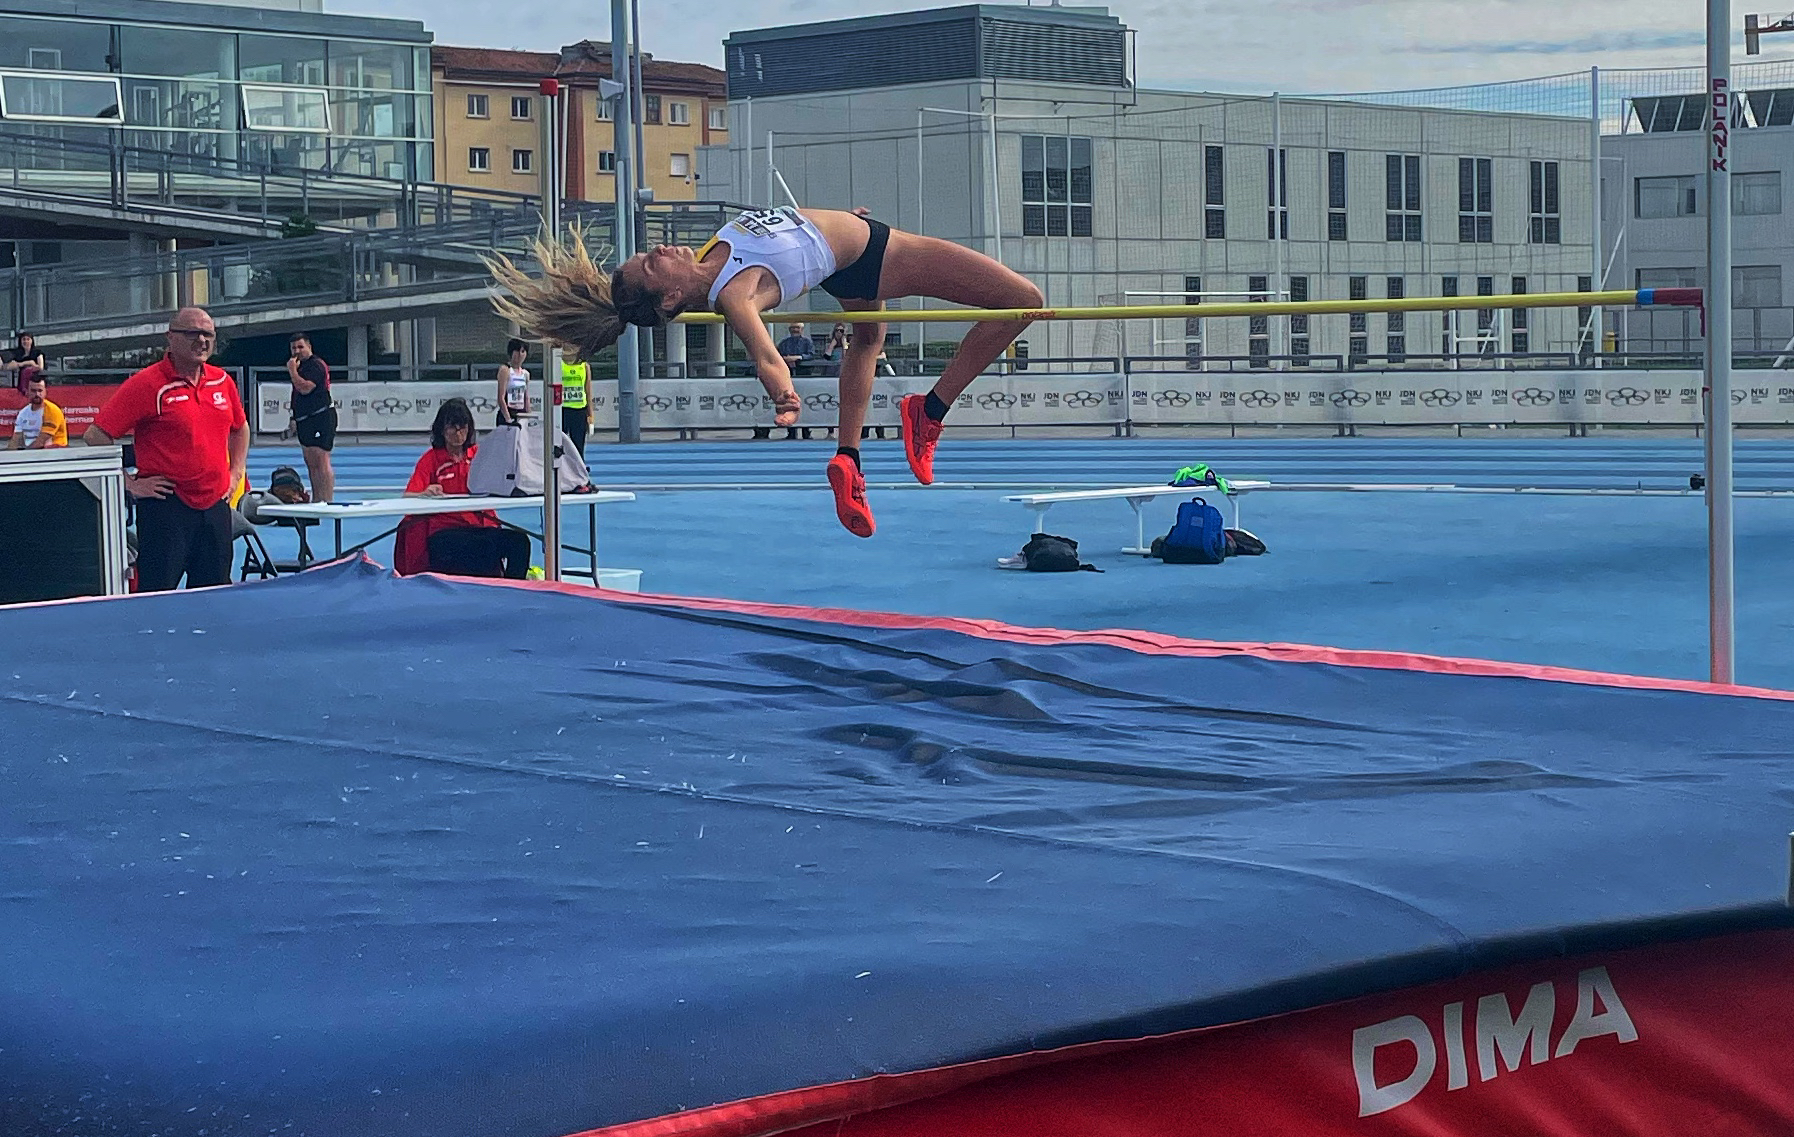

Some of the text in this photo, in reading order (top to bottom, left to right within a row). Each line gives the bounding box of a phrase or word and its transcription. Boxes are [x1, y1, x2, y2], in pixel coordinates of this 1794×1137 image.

[1712, 78, 1728, 172] POLANIK
[1751, 388, 1769, 396] NKJ
[1352, 965, 1639, 1118] DIMA
